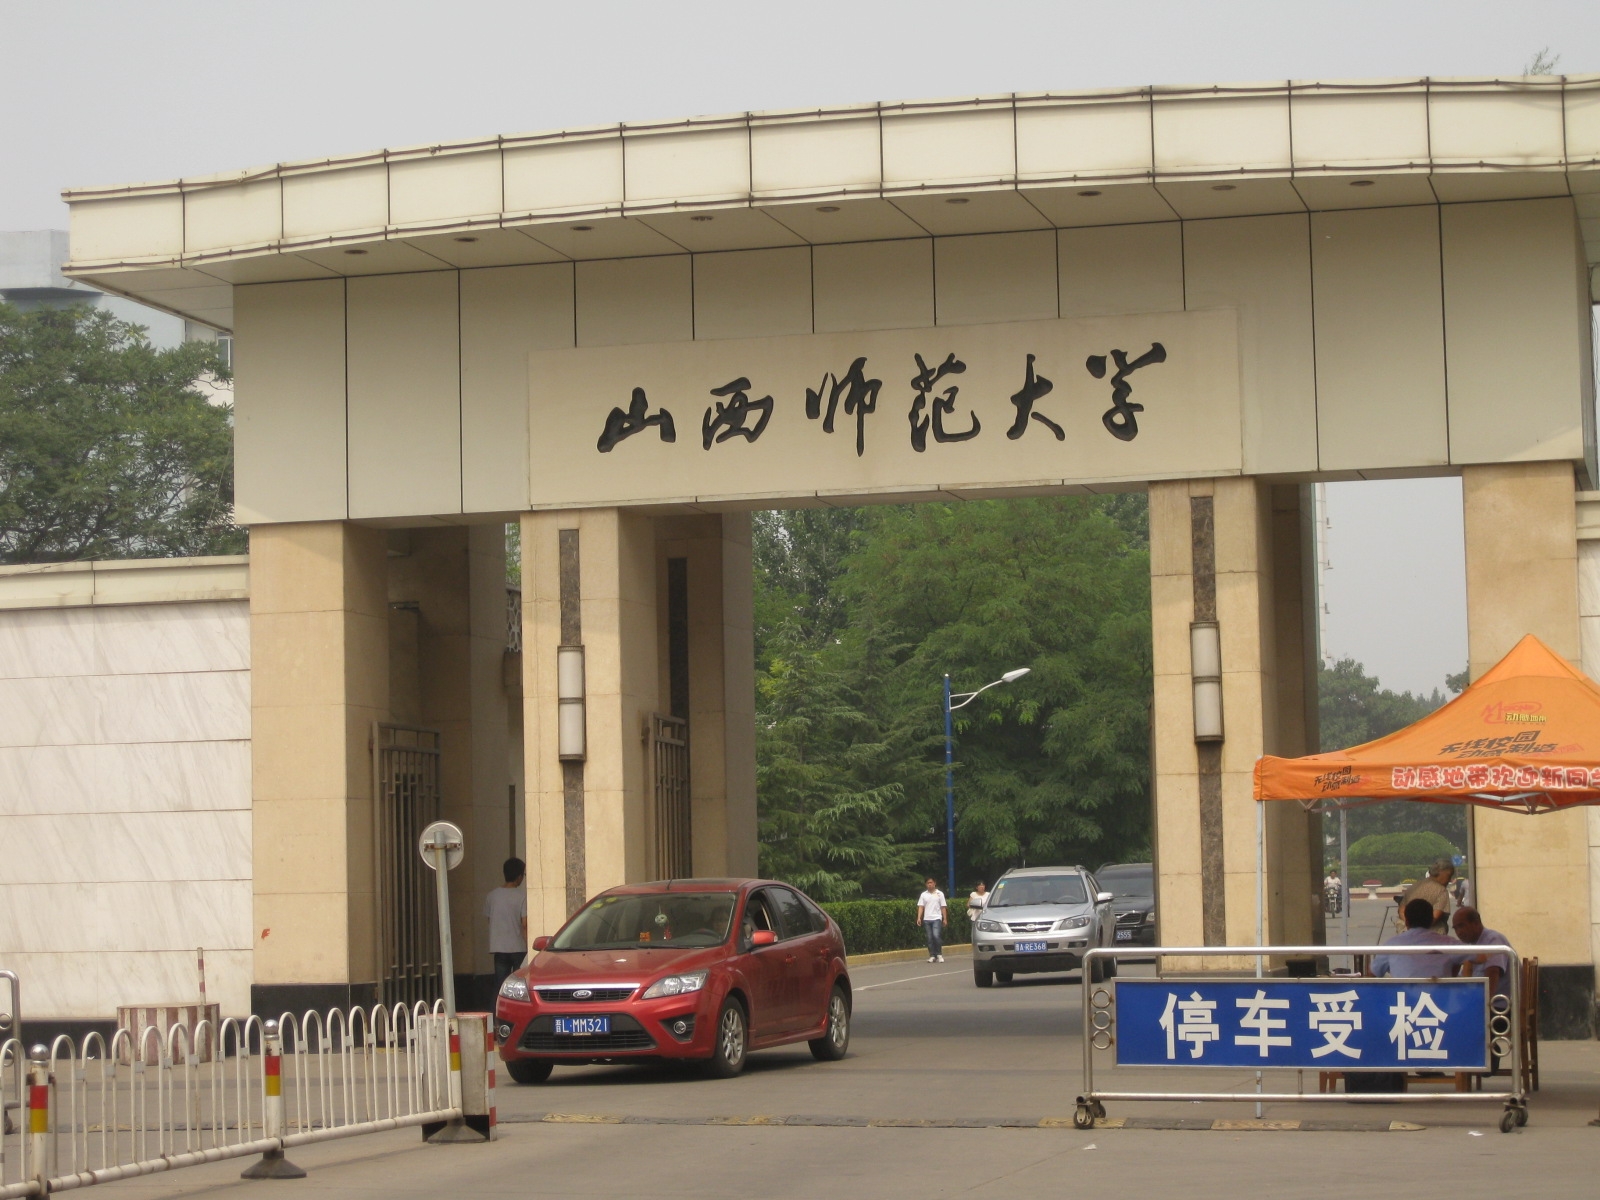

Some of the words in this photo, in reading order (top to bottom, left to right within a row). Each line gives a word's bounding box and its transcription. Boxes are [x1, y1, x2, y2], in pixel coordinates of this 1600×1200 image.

[597, 342, 1167, 457] 山西师范大学
[1158, 989, 1449, 1060] 停车受检
